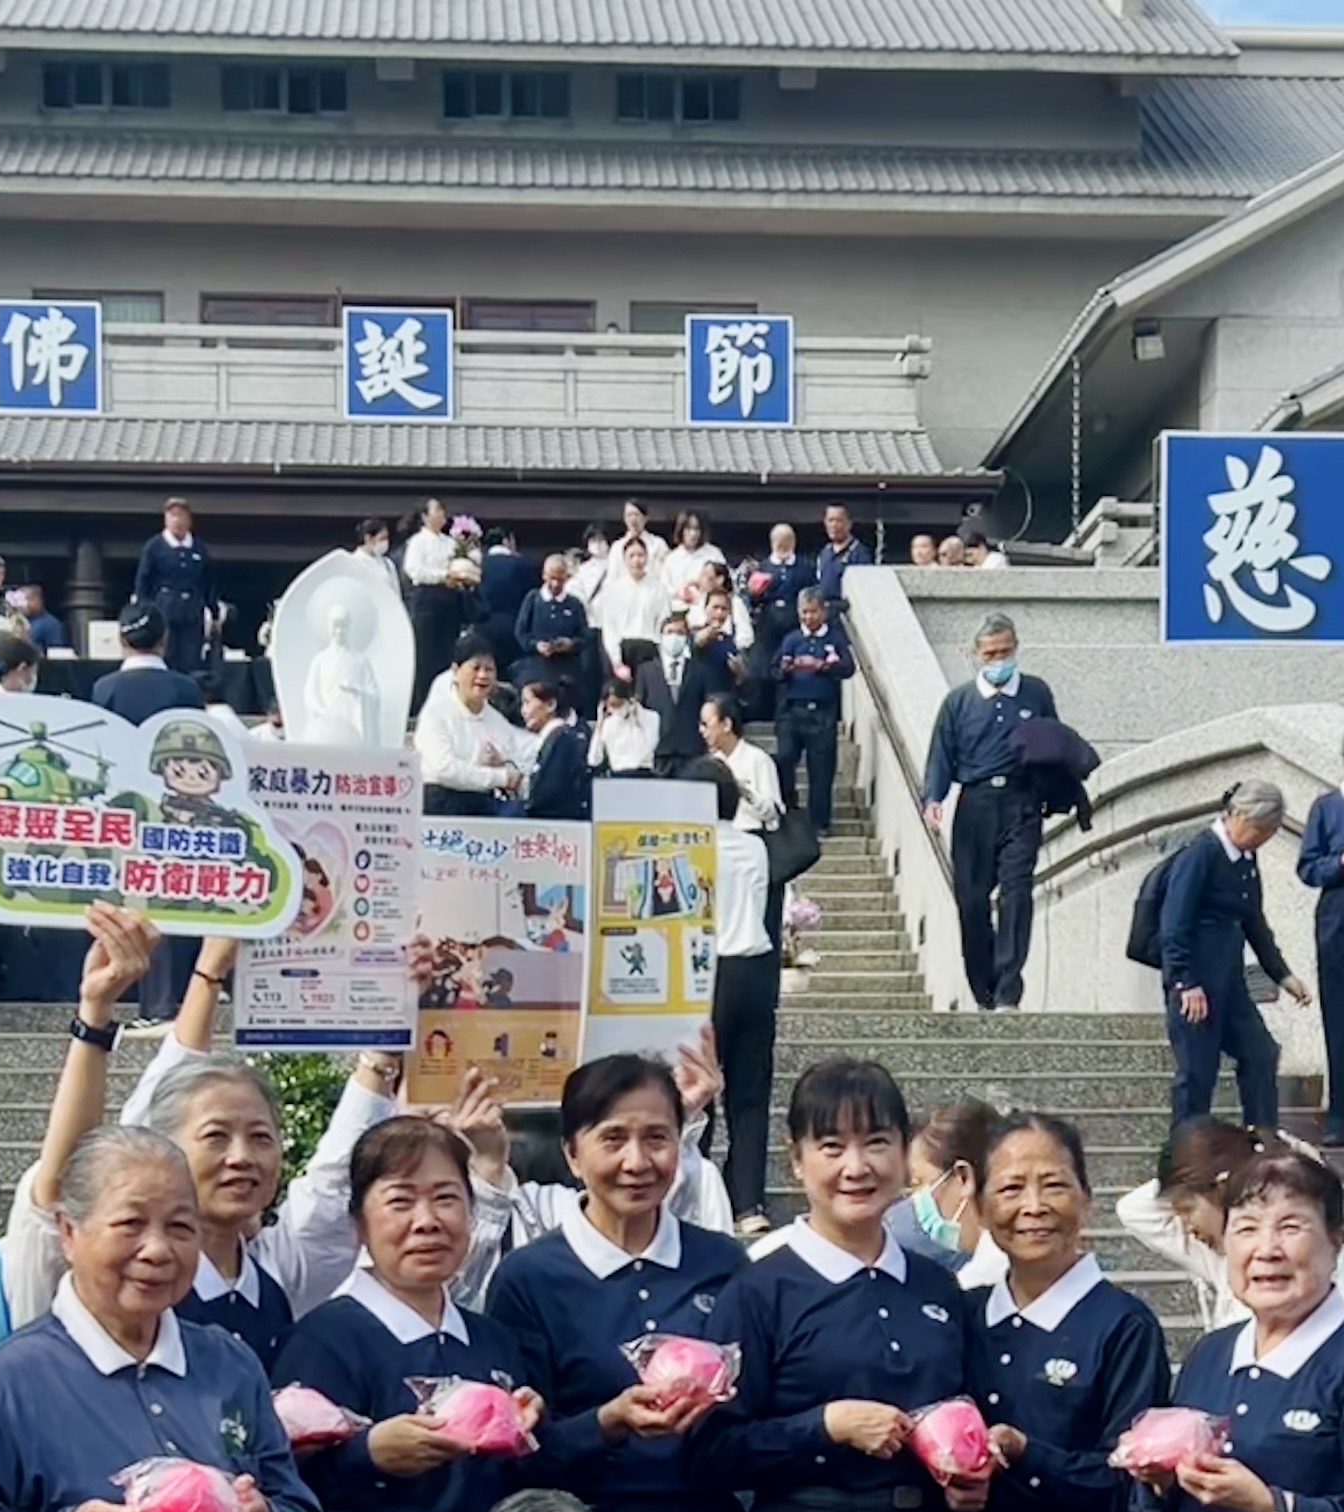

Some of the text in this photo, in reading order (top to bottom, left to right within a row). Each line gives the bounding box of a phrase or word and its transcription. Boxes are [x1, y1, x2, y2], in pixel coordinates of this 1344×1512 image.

[1, 306, 89, 407] 佛
[353, 318, 444, 409] 誕
[703, 323, 775, 419] 節
[1202, 444, 1332, 633] 慈
[5, 856, 270, 899] 強化自我 防衛戰力
[141, 824, 245, 857] 國防共識
